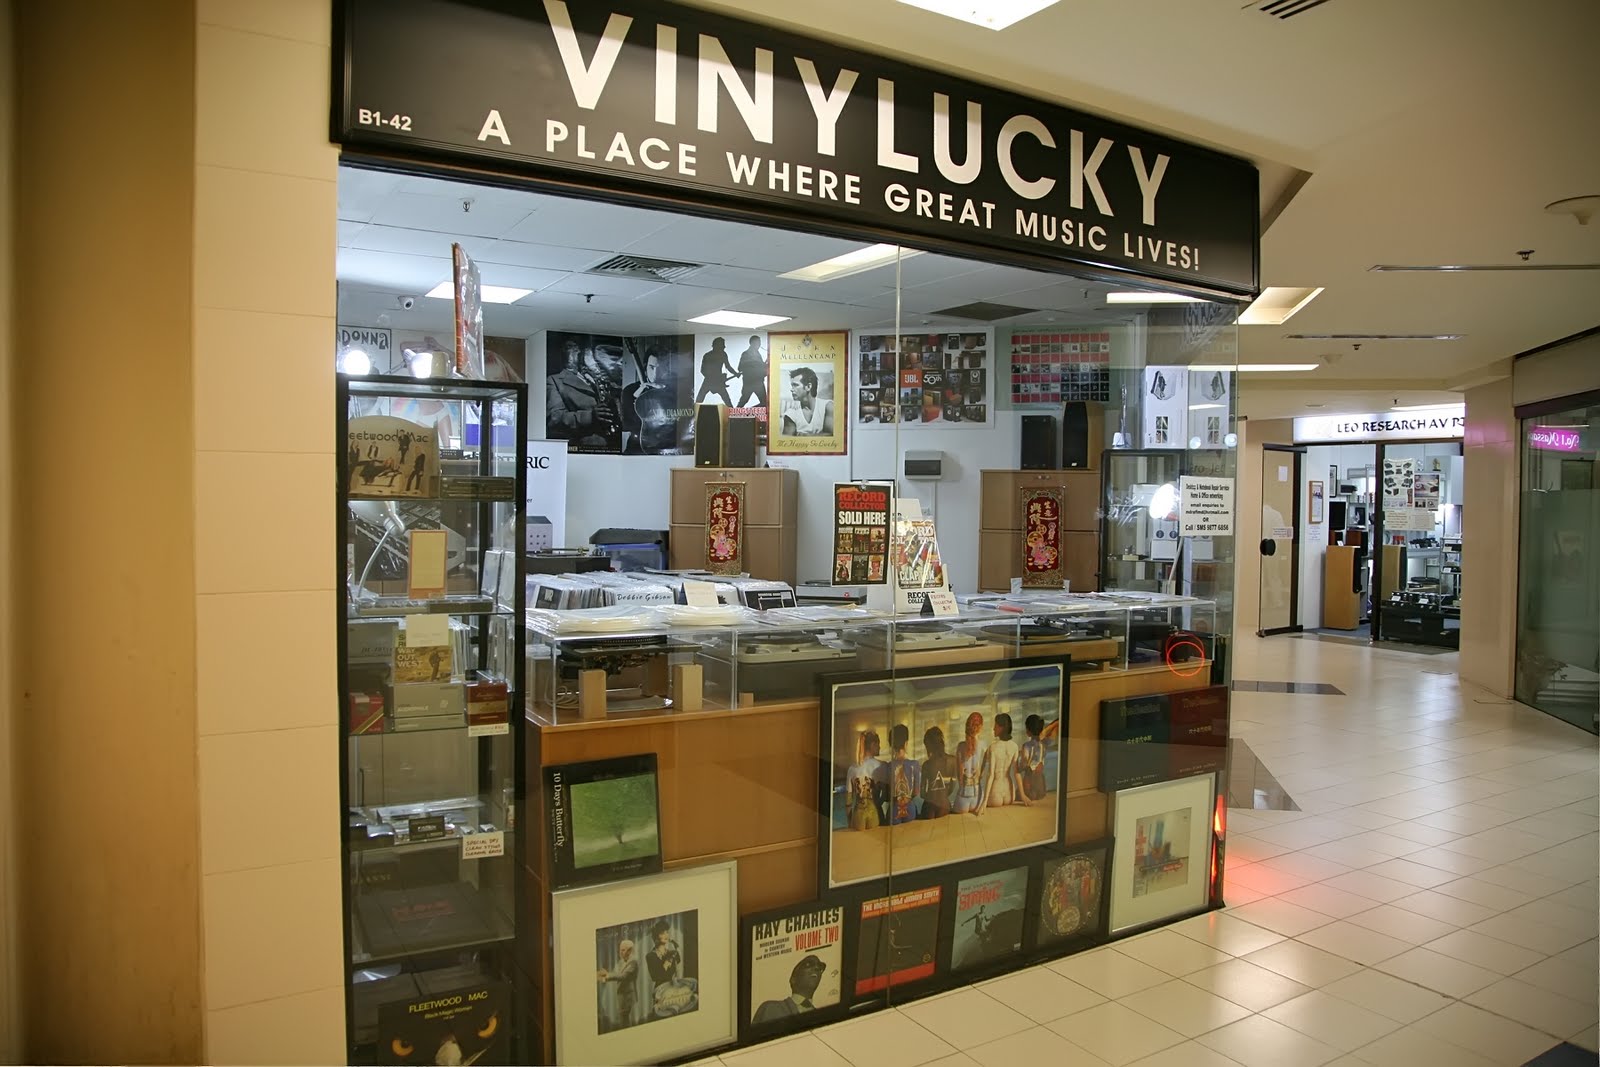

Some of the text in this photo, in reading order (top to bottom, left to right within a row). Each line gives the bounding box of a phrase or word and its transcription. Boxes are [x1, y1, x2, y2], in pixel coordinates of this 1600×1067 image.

[358, 109, 412, 131] B1-42
[543, 0, 1170, 226] VINYLUCKY
[477, 109, 1200, 271] A PLACE WHERE GREAT MUSIC LIVES!
[904, 374, 918, 383] JBL
[1337, 422, 1358, 433] LEO
[1362, 418, 1426, 432] RESEARCH
[1428, 417, 1449, 429] AV
[839, 501, 886, 510] COLLECTOR
[838, 511, 886, 525] SOLD HERE
[616, 593, 673, 601] Debbie Gibson
[553, 772, 561, 783] 10
[553, 784, 562, 806] Days
[555, 808, 565, 847] Butterfly
[755, 920, 780, 941] RAY
[786, 908, 840, 934] CHARLES
[795, 925, 839, 951] VOLUME TWO
[408, 991, 488, 1013] FLEETWOOD MAC
